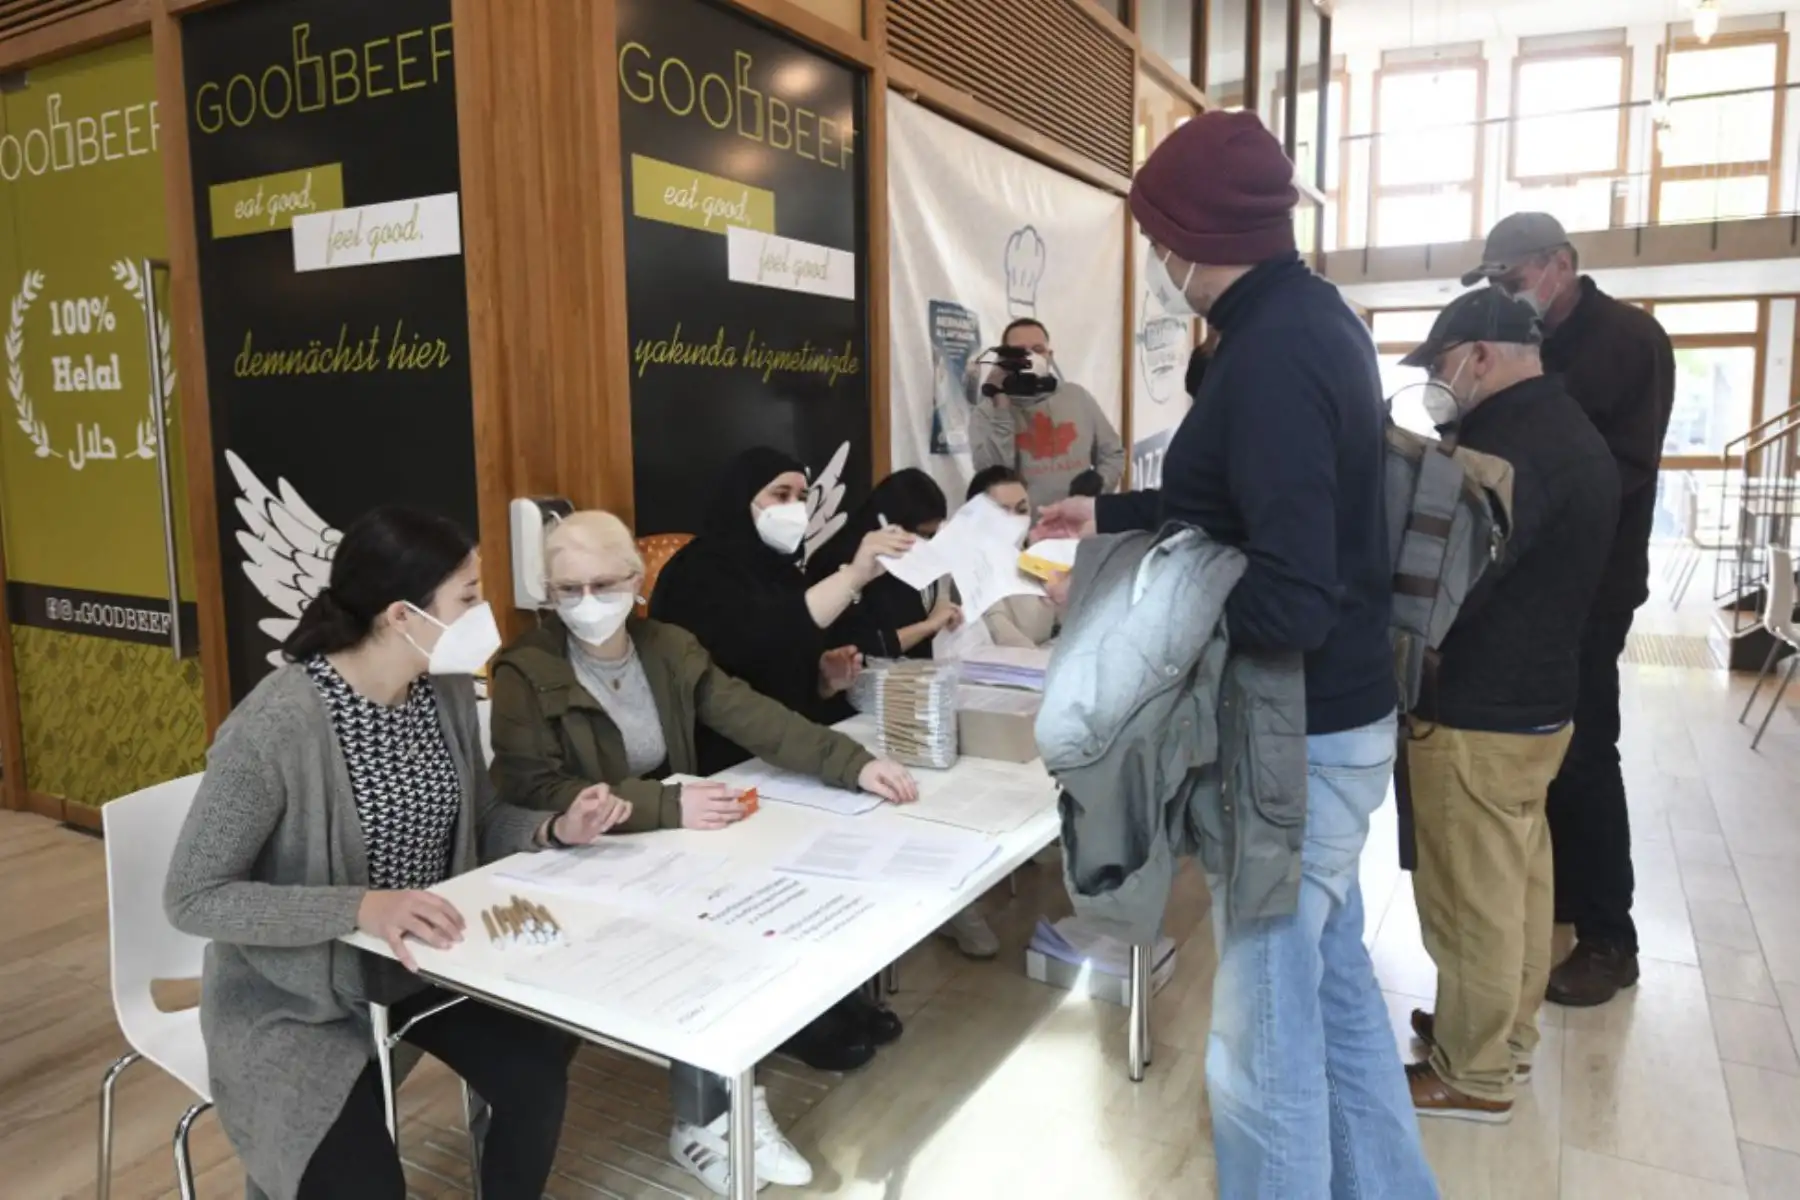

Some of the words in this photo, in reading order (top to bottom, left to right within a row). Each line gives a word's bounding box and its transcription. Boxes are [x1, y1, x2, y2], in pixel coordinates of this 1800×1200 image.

[234, 184, 265, 220] eat
[663, 178, 700, 211] eat
[326, 220, 363, 266] feel
[49, 295, 117, 336] 100%
[234, 322, 381, 378] demnächst
[386, 318, 451, 370] hier
[51, 352, 123, 392] Helal
[67, 421, 118, 472] حلال
